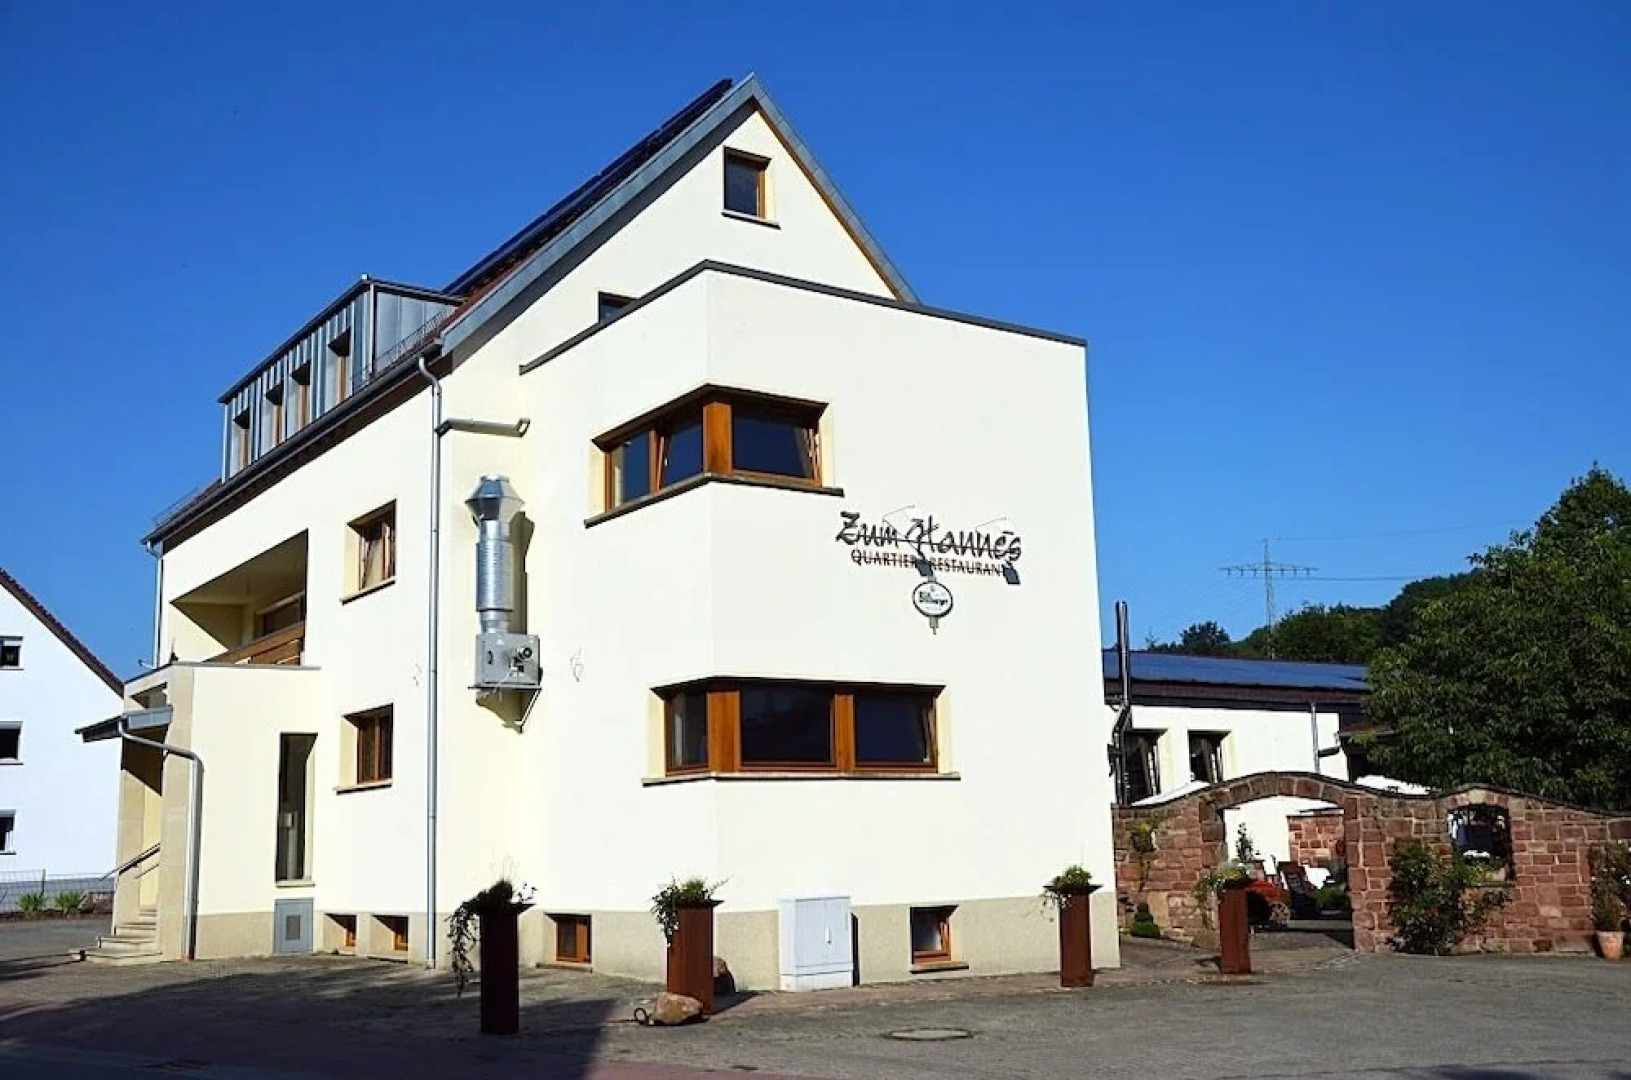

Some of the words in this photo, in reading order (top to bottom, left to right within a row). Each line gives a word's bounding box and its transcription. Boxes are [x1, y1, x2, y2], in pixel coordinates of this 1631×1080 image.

[835, 510, 899, 549] Zum
[850, 549, 918, 569] QUARTIER
[929, 557, 1006, 577] RESTAURAN
